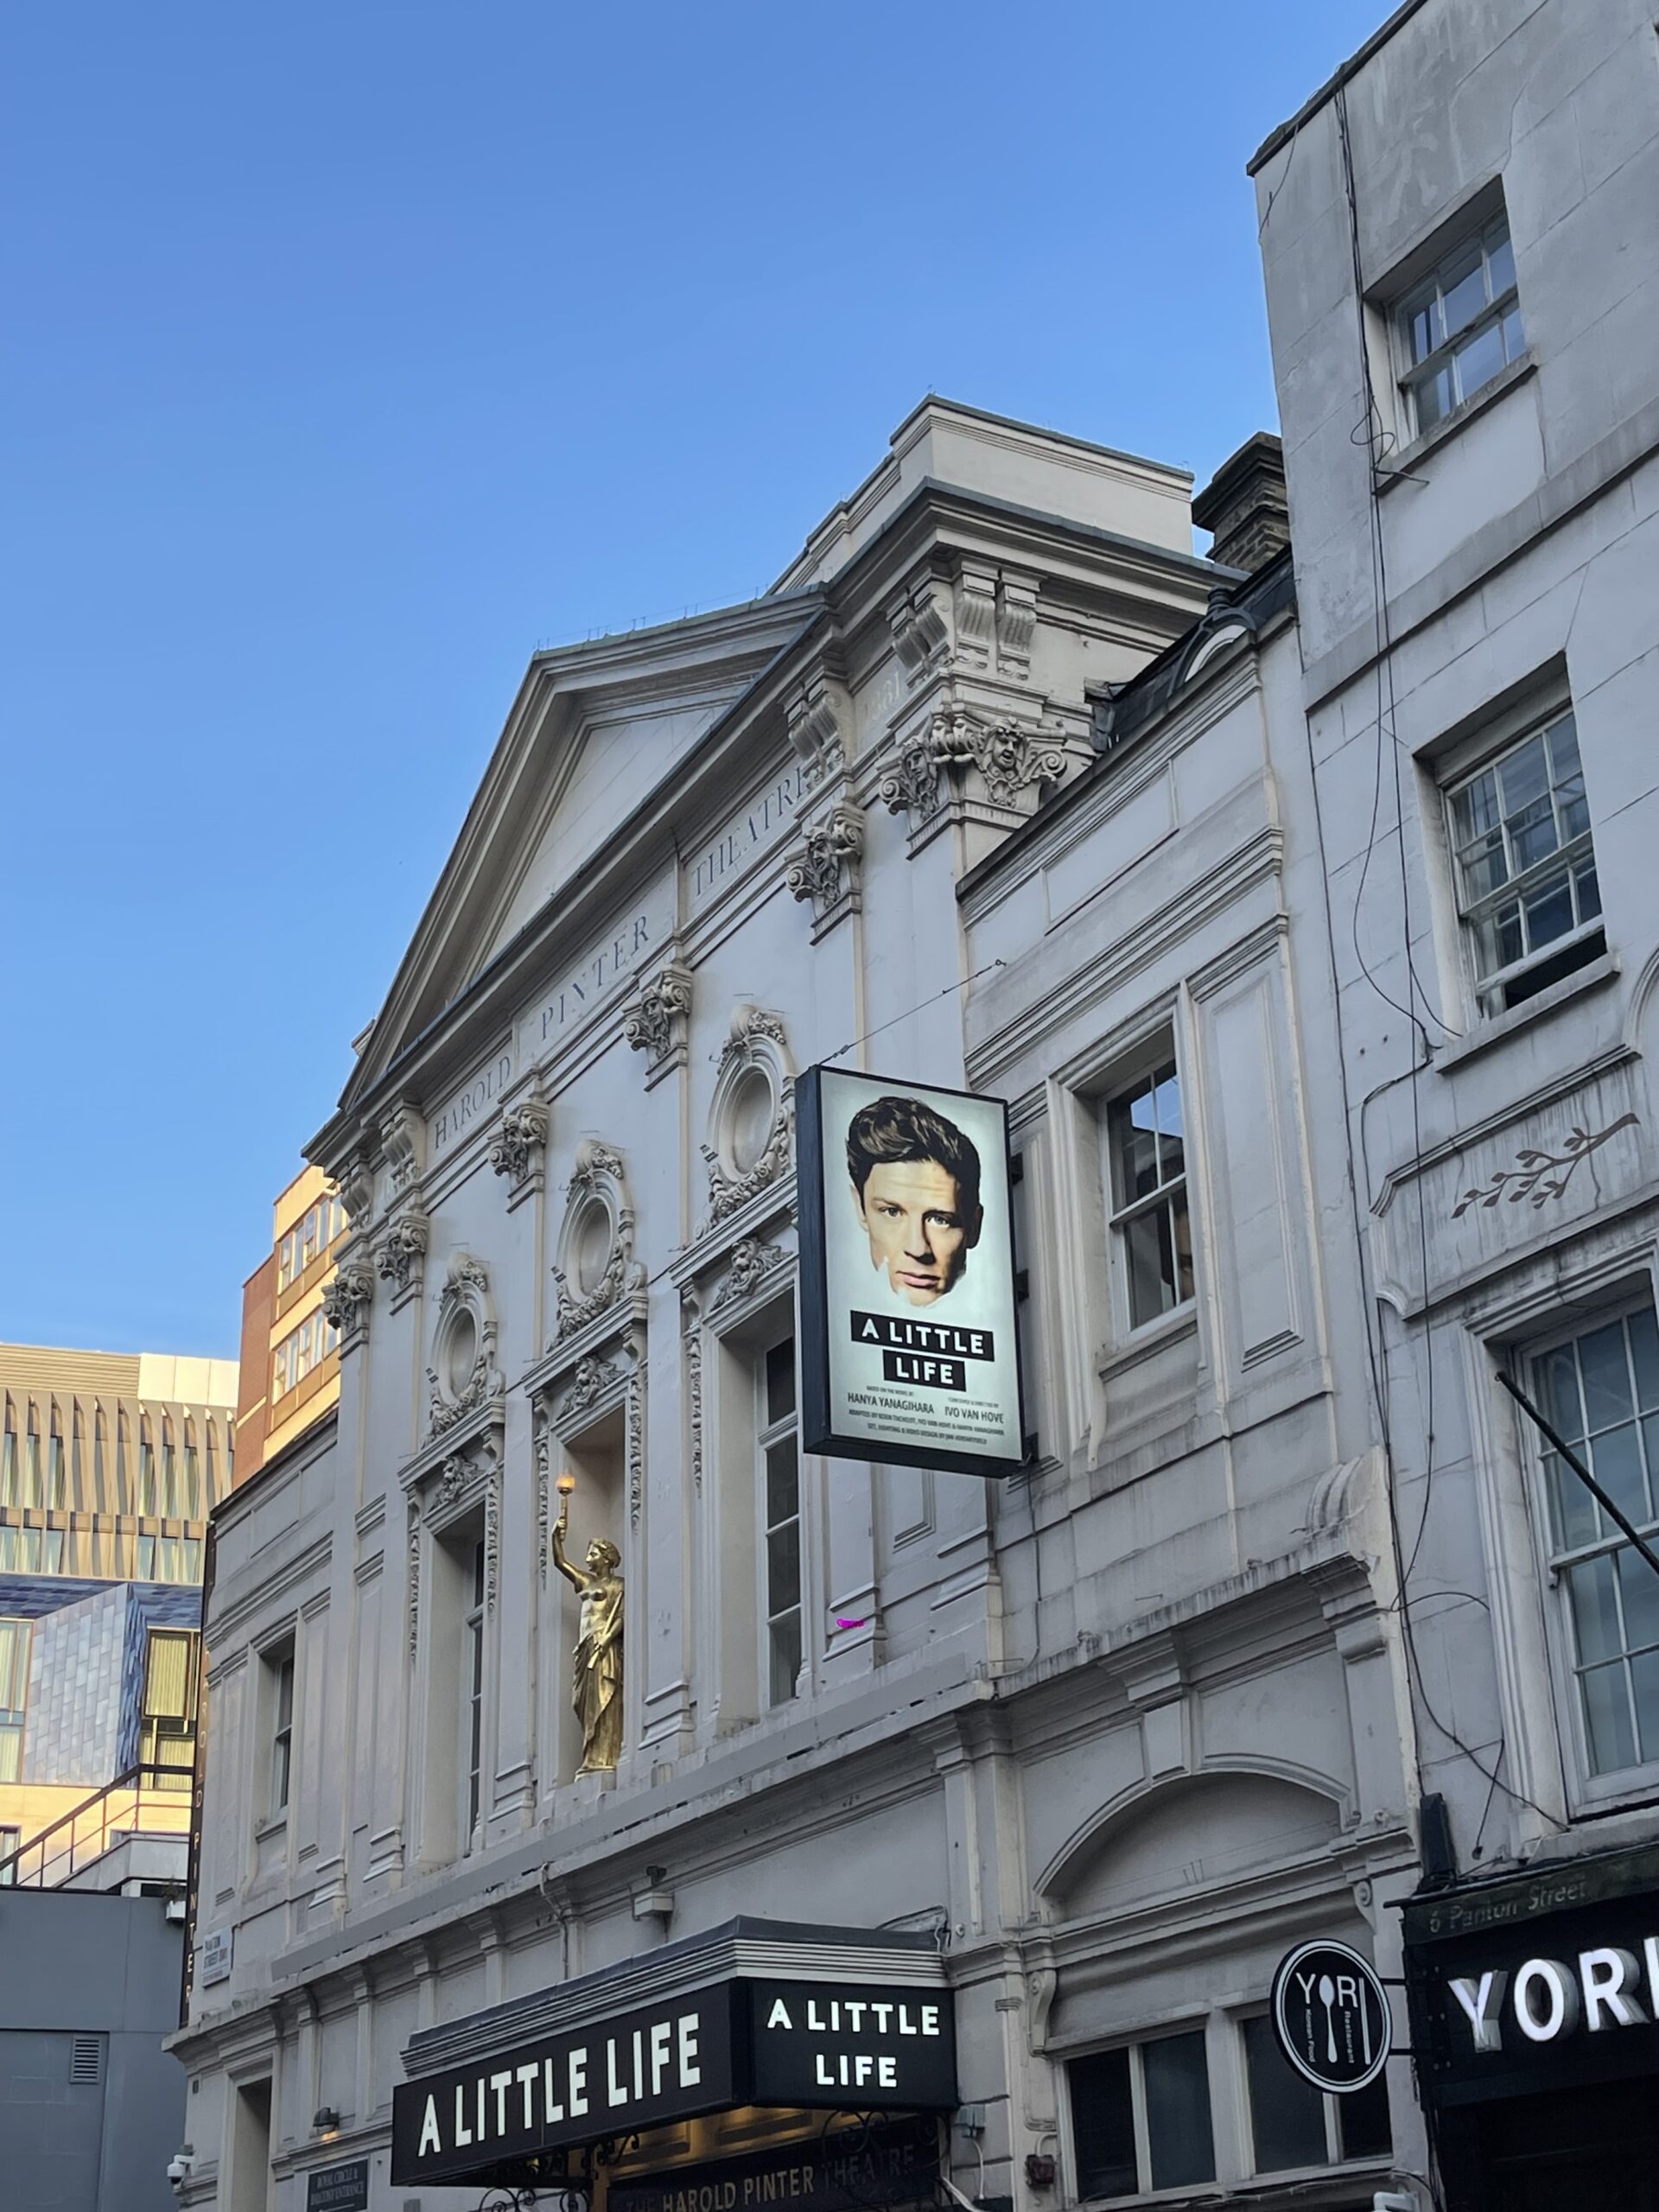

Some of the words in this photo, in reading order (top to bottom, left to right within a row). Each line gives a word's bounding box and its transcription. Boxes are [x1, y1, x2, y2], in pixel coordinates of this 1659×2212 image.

[435, 1056, 511, 1150] HAROLD
[541, 916, 649, 1041] PINTER
[861, 1318, 880, 1339] A
[889, 1321, 983, 1355] LITTLE
[896, 1357, 953, 1384] LIFE
[848, 1392, 877, 1407] HANYA
[879, 1397, 934, 1414] YANAGIHARA
[944, 1406, 959, 1418] IVO
[961, 1408, 979, 1421] VAN
[982, 1411, 1004, 1424] HOVE
[1450, 1903, 1517, 1929] Panton
[1529, 1881, 1586, 1910] Street
[1448, 1936, 1659, 2054] YORI
[768, 1999, 793, 2030] A
[808, 1999, 939, 2036] LITTLE
[1344, 2010, 1355, 2063] Restaurant
[418, 2094, 442, 2157] A
[455, 2047, 589, 2147] LITTLE
[607, 2013, 701, 2107] LIFE
[816, 2054, 897, 2088] LIFE
[663, 2182, 736, 2212] HAROLD
[743, 2165, 814, 2206] PINTER
